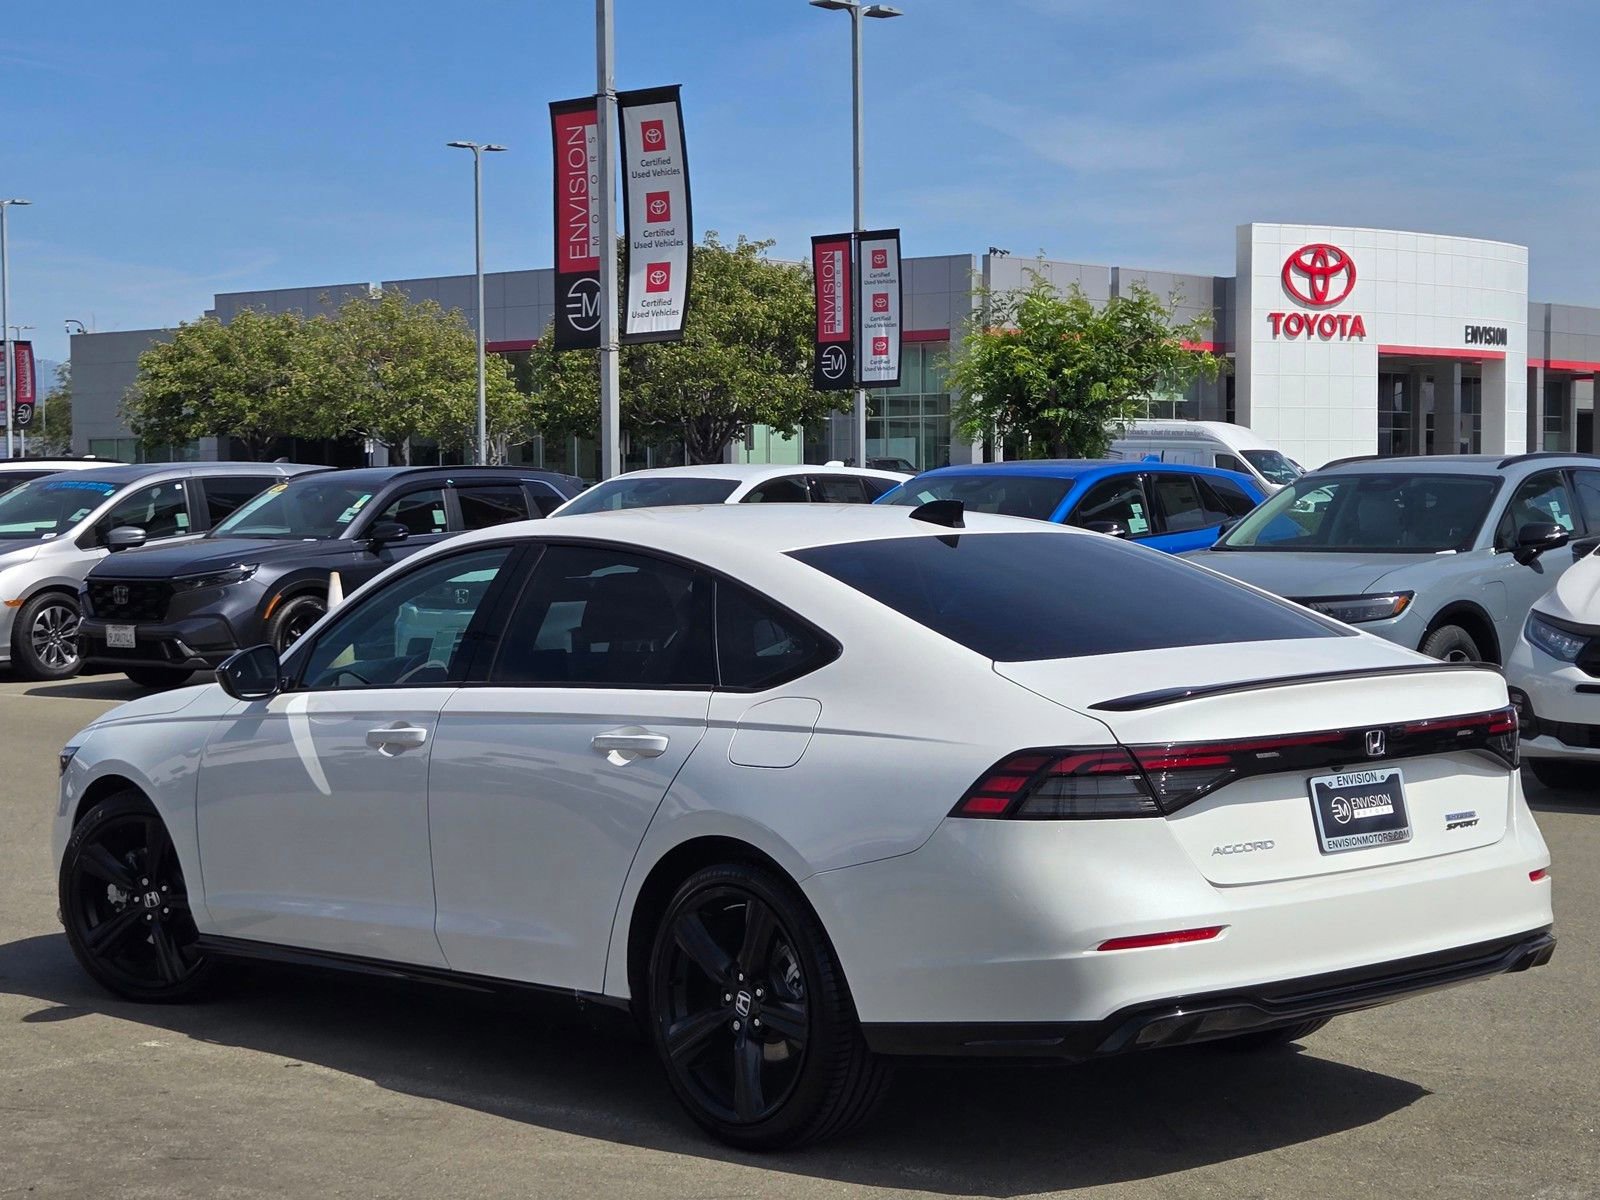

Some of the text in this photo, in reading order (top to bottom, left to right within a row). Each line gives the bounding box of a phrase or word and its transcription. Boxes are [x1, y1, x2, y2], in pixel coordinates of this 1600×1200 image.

[640, 156, 671, 167] Certified
[631, 167, 680, 178] Used Vehicles
[566, 125, 588, 259] ENVISION
[589, 136, 600, 247] MOTORS
[643, 228, 675, 238] Certified
[634, 238, 684, 249] Used Vehicles
[869, 271, 890, 279] Certified
[822, 250, 836, 335] ENVISION
[641, 297, 672, 307] Certified
[631, 308, 679, 318] Used Vehicles
[1268, 312, 1367, 339] TOYOTA
[1464, 325, 1508, 346] ENVISION
[1336, 772, 1378, 786] ENVISION
[1351, 794, 1392, 809] ENVISION
[1446, 818, 1480, 830] SPORT
[1327, 829, 1410, 849] ENVISIONMOTORS.COM
[1211, 840, 1275, 856] ACCORD
